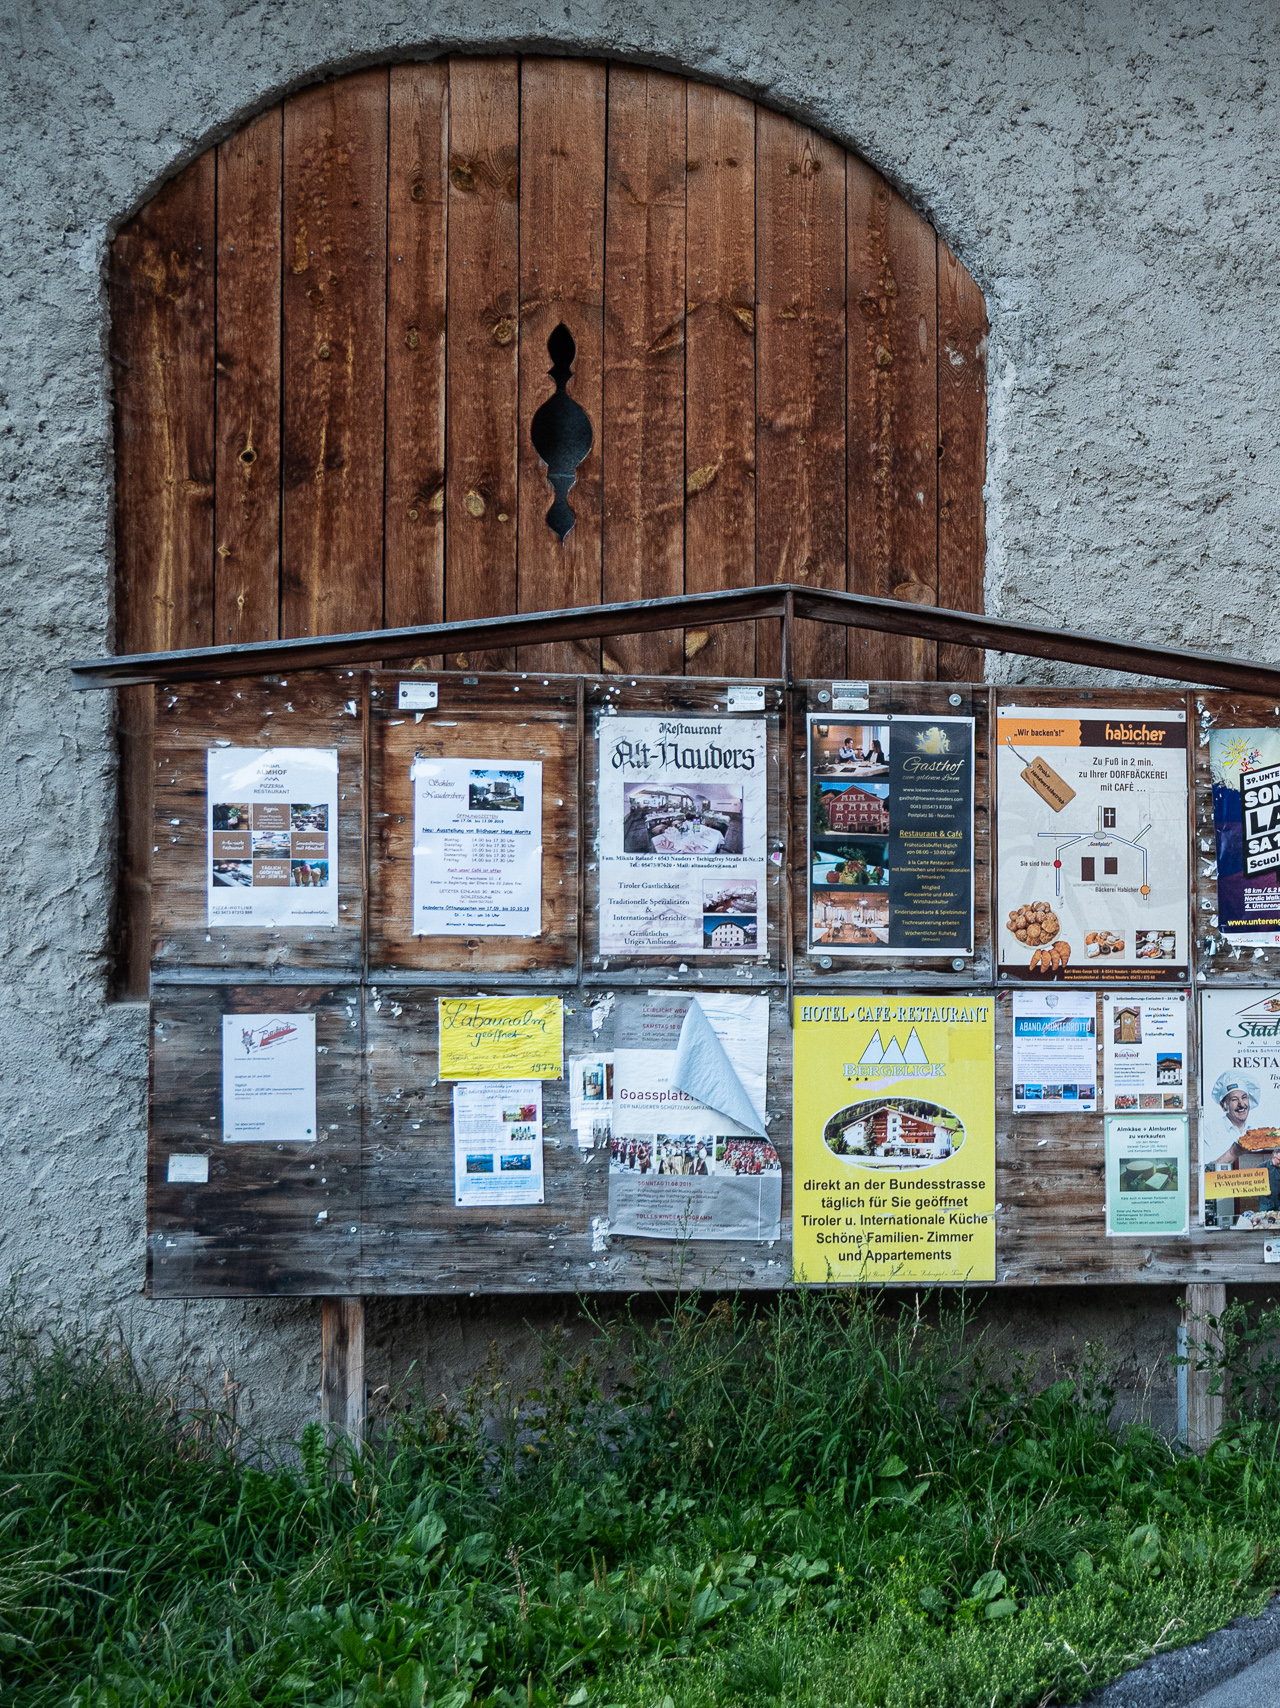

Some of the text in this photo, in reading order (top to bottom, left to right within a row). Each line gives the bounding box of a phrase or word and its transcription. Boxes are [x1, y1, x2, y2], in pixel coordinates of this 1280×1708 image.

[659, 723, 723, 738] Restaurant
[1105, 723, 1167, 742] habicher
[611, 737, 755, 771] Alt-Nauders
[903, 756, 964, 776] Gasthof
[1093, 757, 1154, 767] Zu Fuß in 2 min.
[1036, 763, 1051, 779] Tiroler
[1090, 770, 1108, 779] Ihrer
[1109, 768, 1168, 780] DORFBÄCKEREI
[1030, 770, 1065, 806] Handwerksbetrieb
[1100, 783, 1113, 791] mit
[1245, 777, 1259, 786] 39.
[899, 830, 938, 838] Restaurant
[946, 830, 963, 838] Café
[1248, 836, 1273, 855] SA
[1250, 852, 1280, 869] Scuol
[608, 898, 690, 907] Traditionelle Spezialitäten
[624, 938, 646, 946] Uriges
[801, 1006, 988, 1023] HOTEL CAFE RESTAURANT
[1019, 1022, 1091, 1033] ABANO/MONTEGROTTO
[470, 1029, 525, 1048] geöffnet
[843, 1063, 946, 1077] BERGBLICK
[1216, 1172, 1242, 1180] Bekannt
[803, 1178, 986, 1191] direkt an der Bundesstrasse
[1214, 1179, 1252, 1188] TV-Werbung
[1232, 1185, 1268, 1194] TV-Kochen!
[821, 1196, 968, 1210] täglich für Sie geöffnet
[801, 1213, 988, 1226] Tiroler u. Internationale Küche
[816, 1231, 974, 1244] Schöne Familien- Zimmer
[838, 1249, 952, 1263] und Appartements
